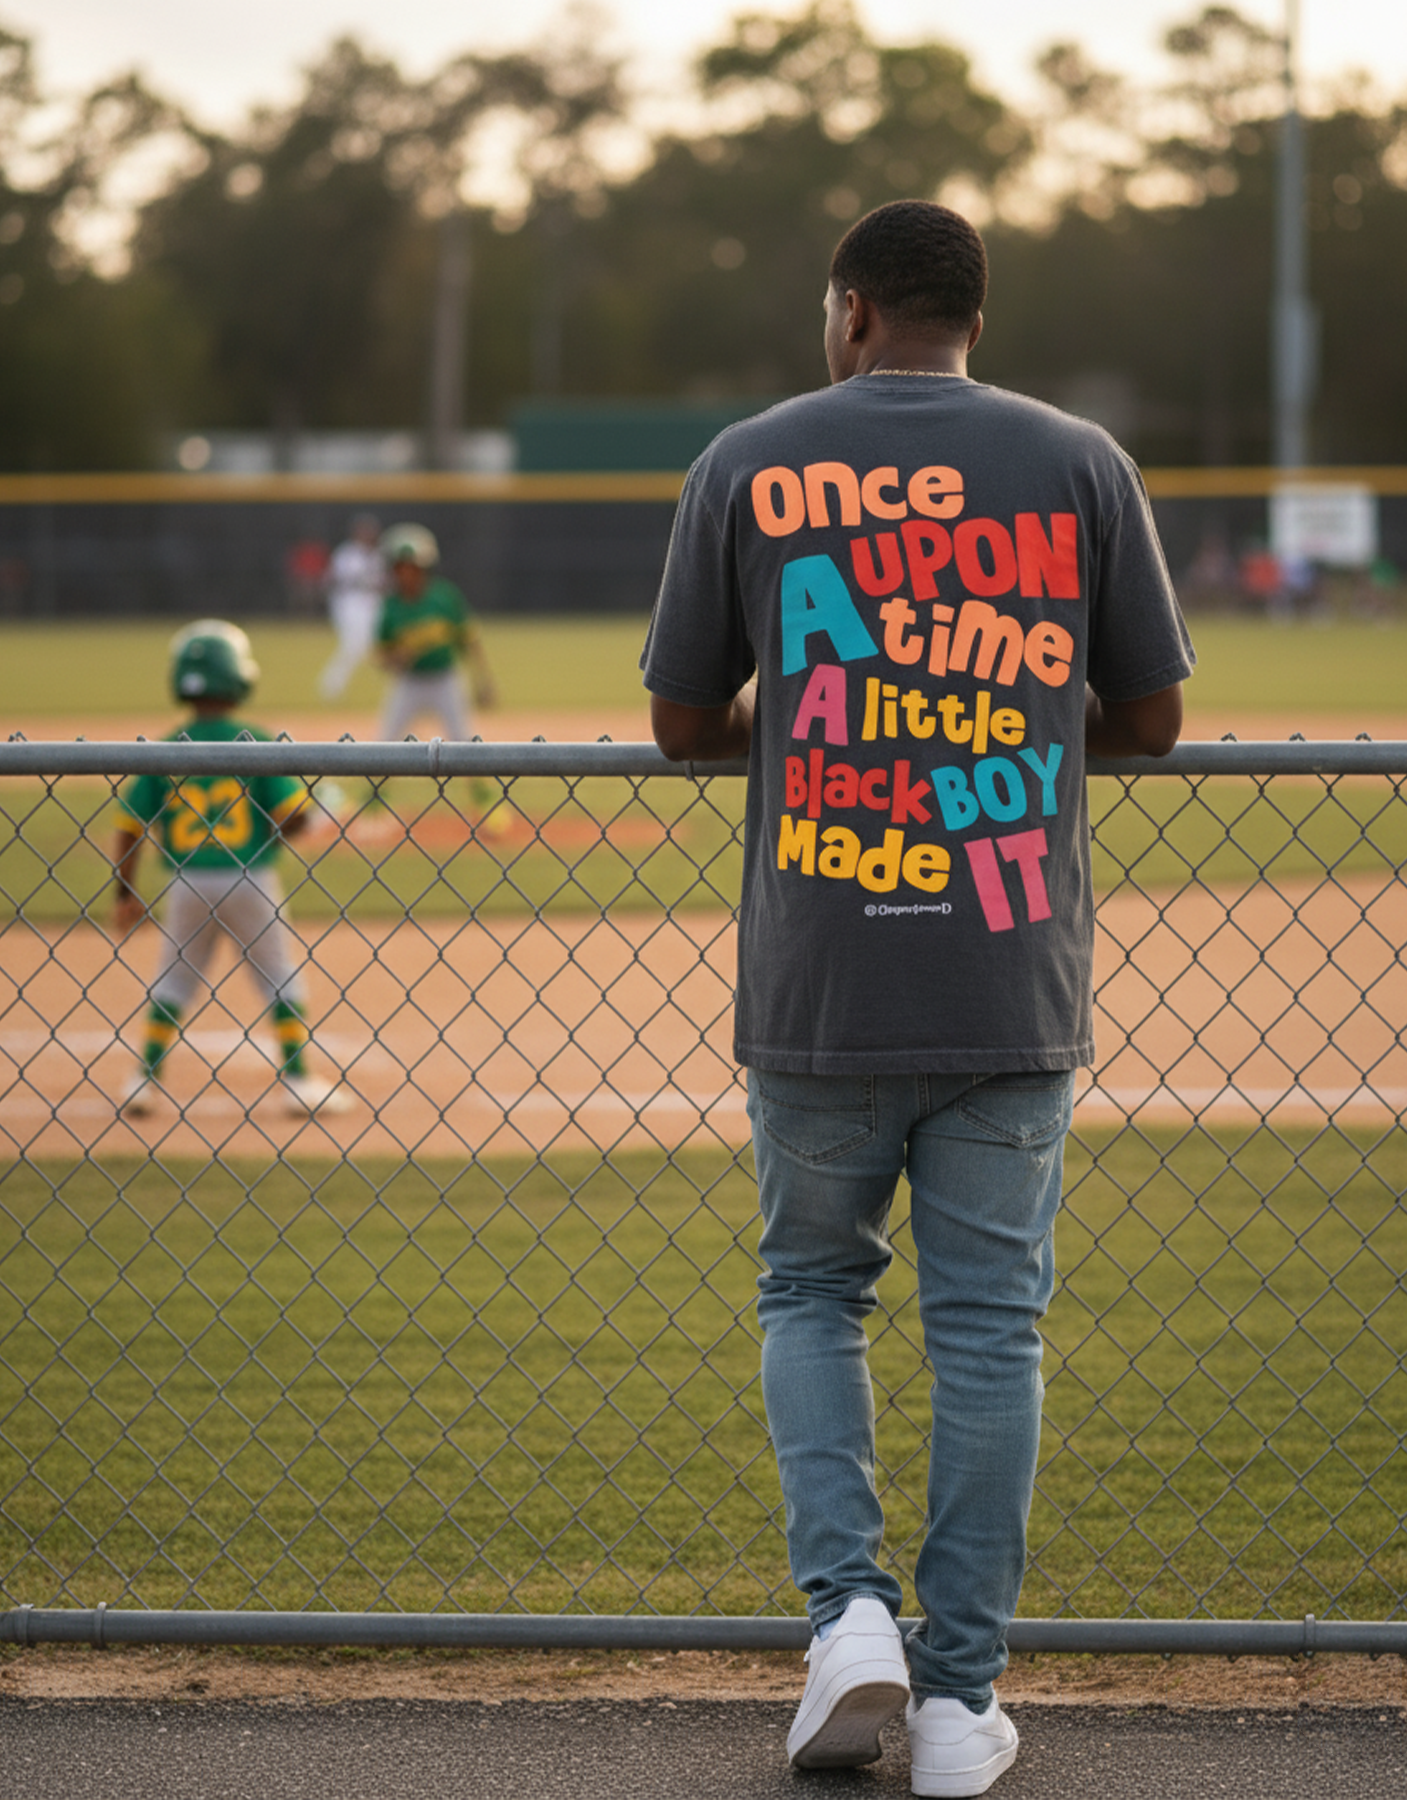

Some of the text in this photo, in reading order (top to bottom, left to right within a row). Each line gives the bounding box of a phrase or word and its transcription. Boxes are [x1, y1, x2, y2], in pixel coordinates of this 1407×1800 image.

[850, 512, 1080, 601] UPON
[781, 554, 1074, 687] A time
[792, 664, 1026, 754] A little
[166, 779, 253, 853] 23
[785, 742, 1064, 831] Black BOY
[777, 814, 1052, 932] Made IT
